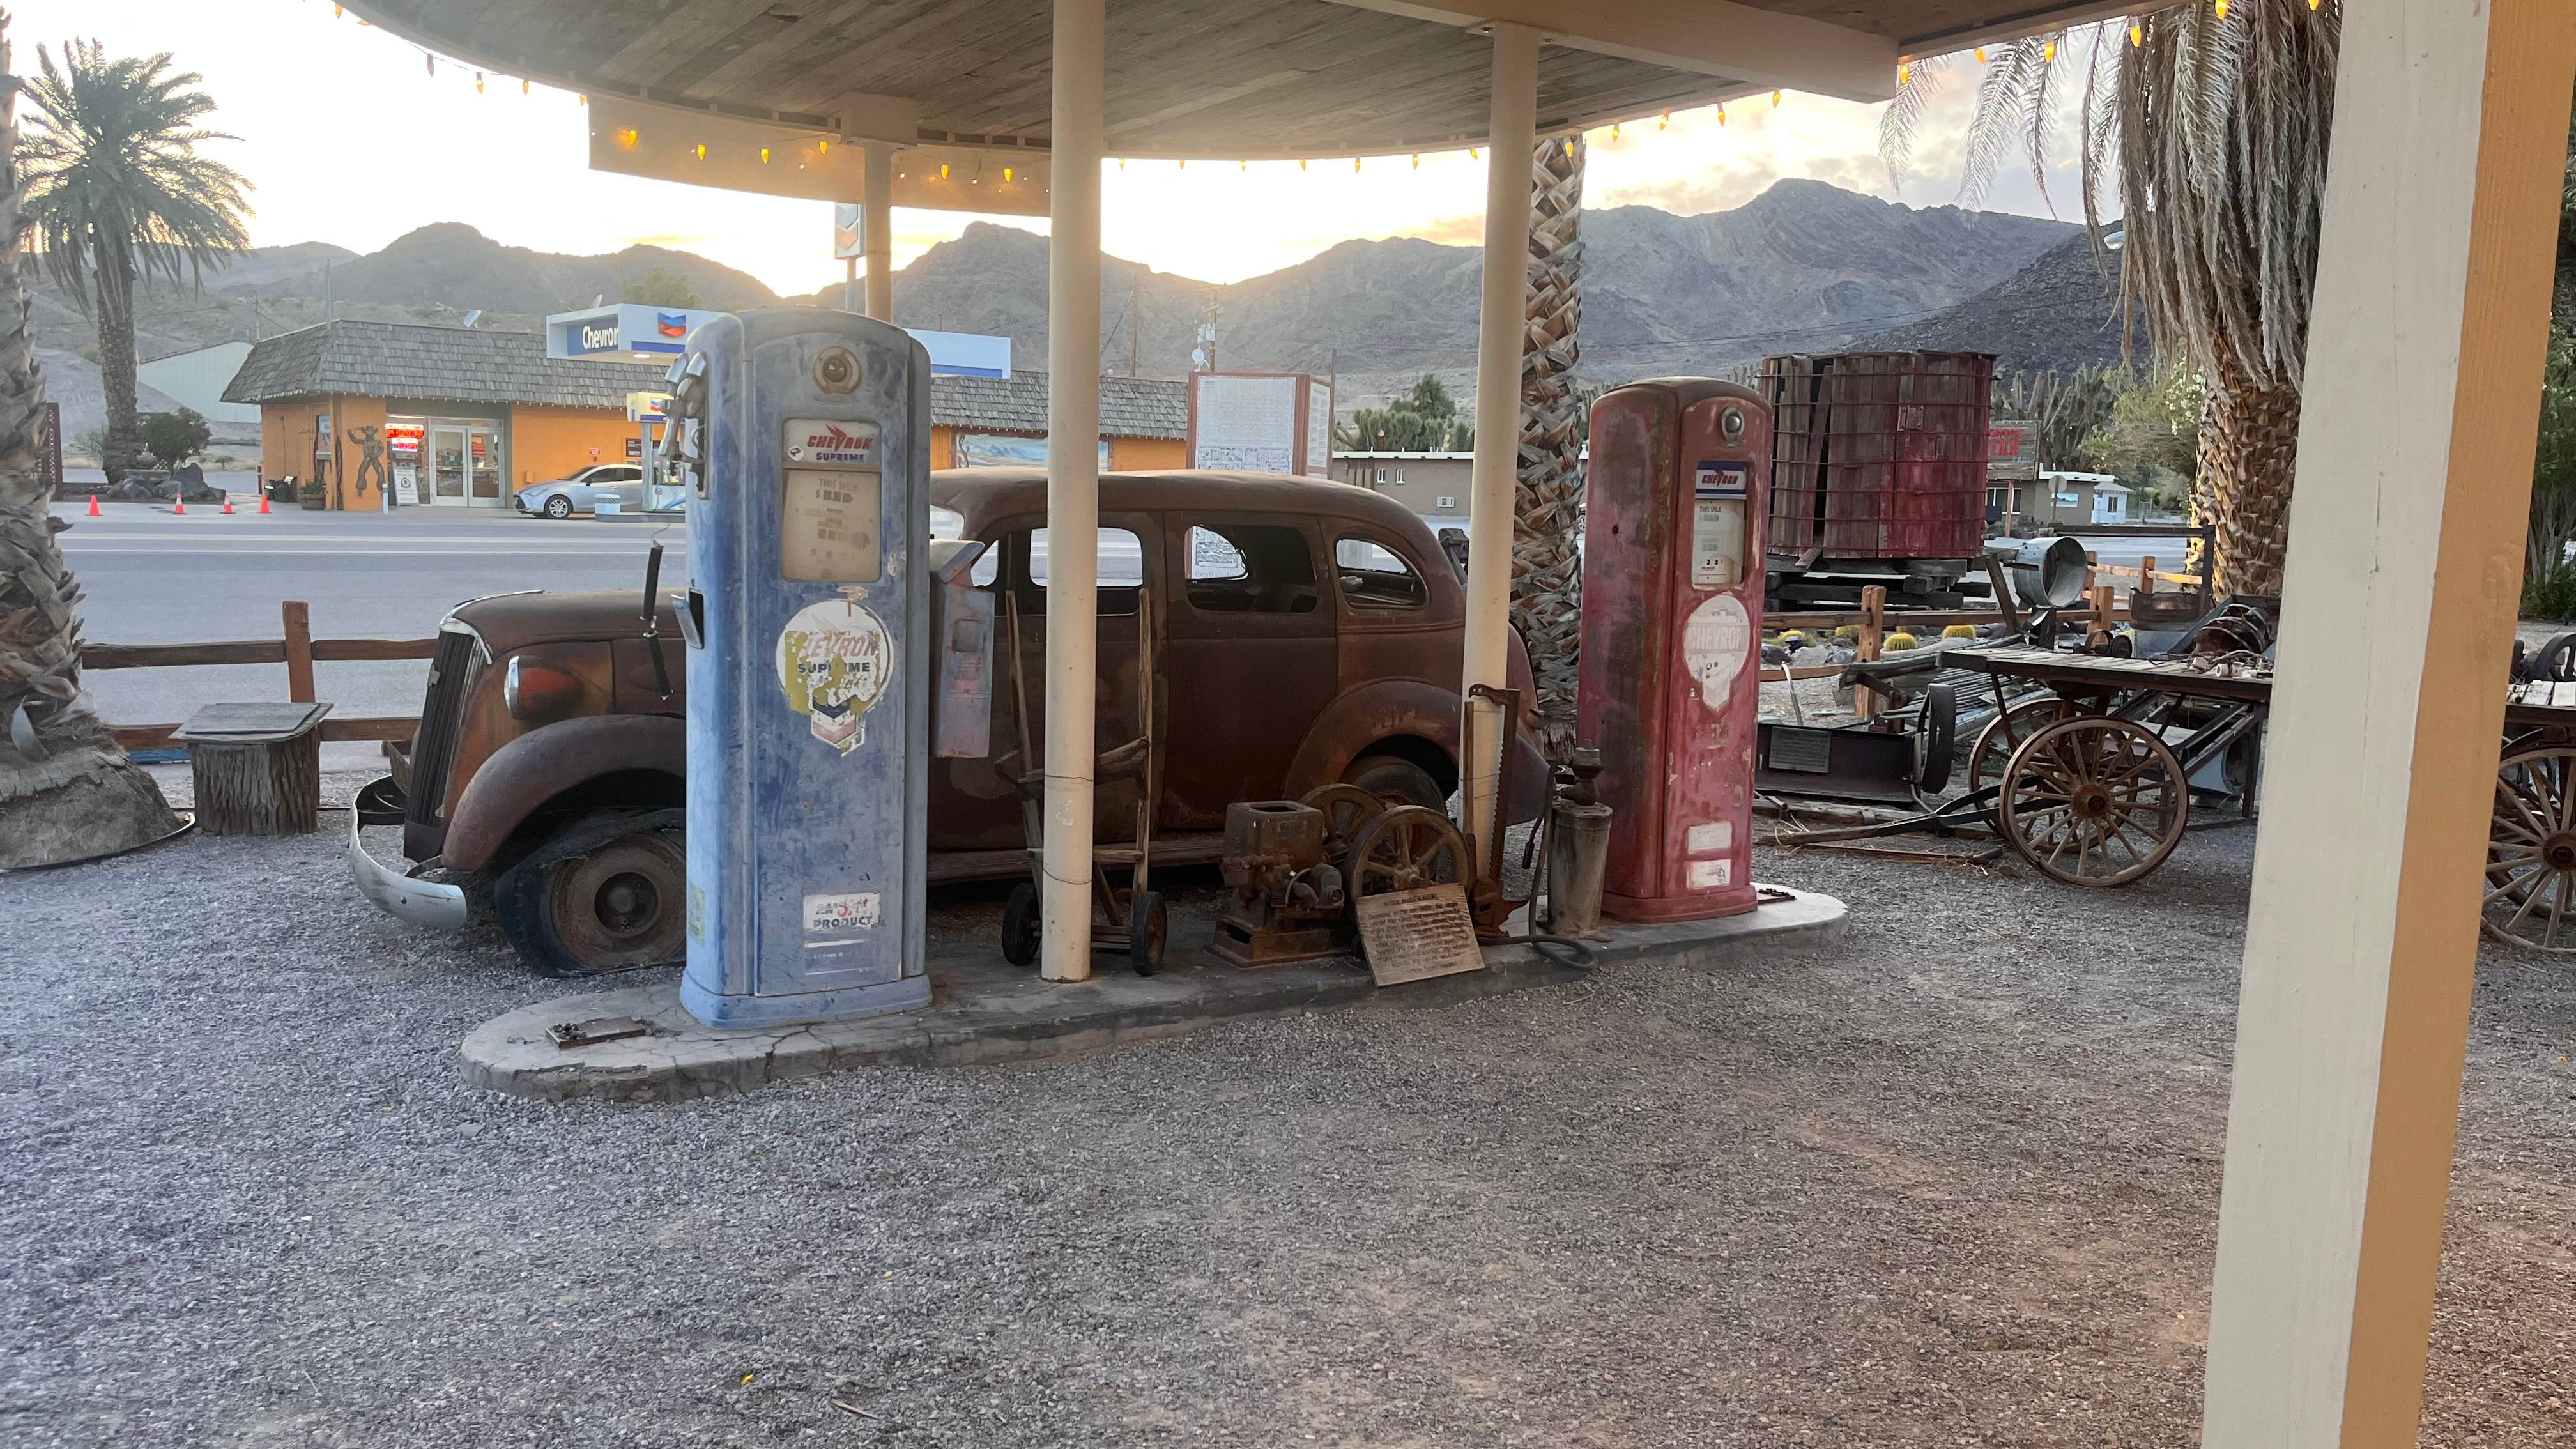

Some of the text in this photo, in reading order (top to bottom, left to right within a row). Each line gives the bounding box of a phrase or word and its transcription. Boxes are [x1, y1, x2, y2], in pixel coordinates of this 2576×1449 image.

[582, 325, 618, 349] Chevron
[807, 425, 873, 451] CHEVRON
[816, 452, 865, 461] SUPREME
[1701, 471, 1738, 486] CHEVRON
[798, 662, 870, 673] SUPME
[813, 916, 873, 928] PRODUCT
